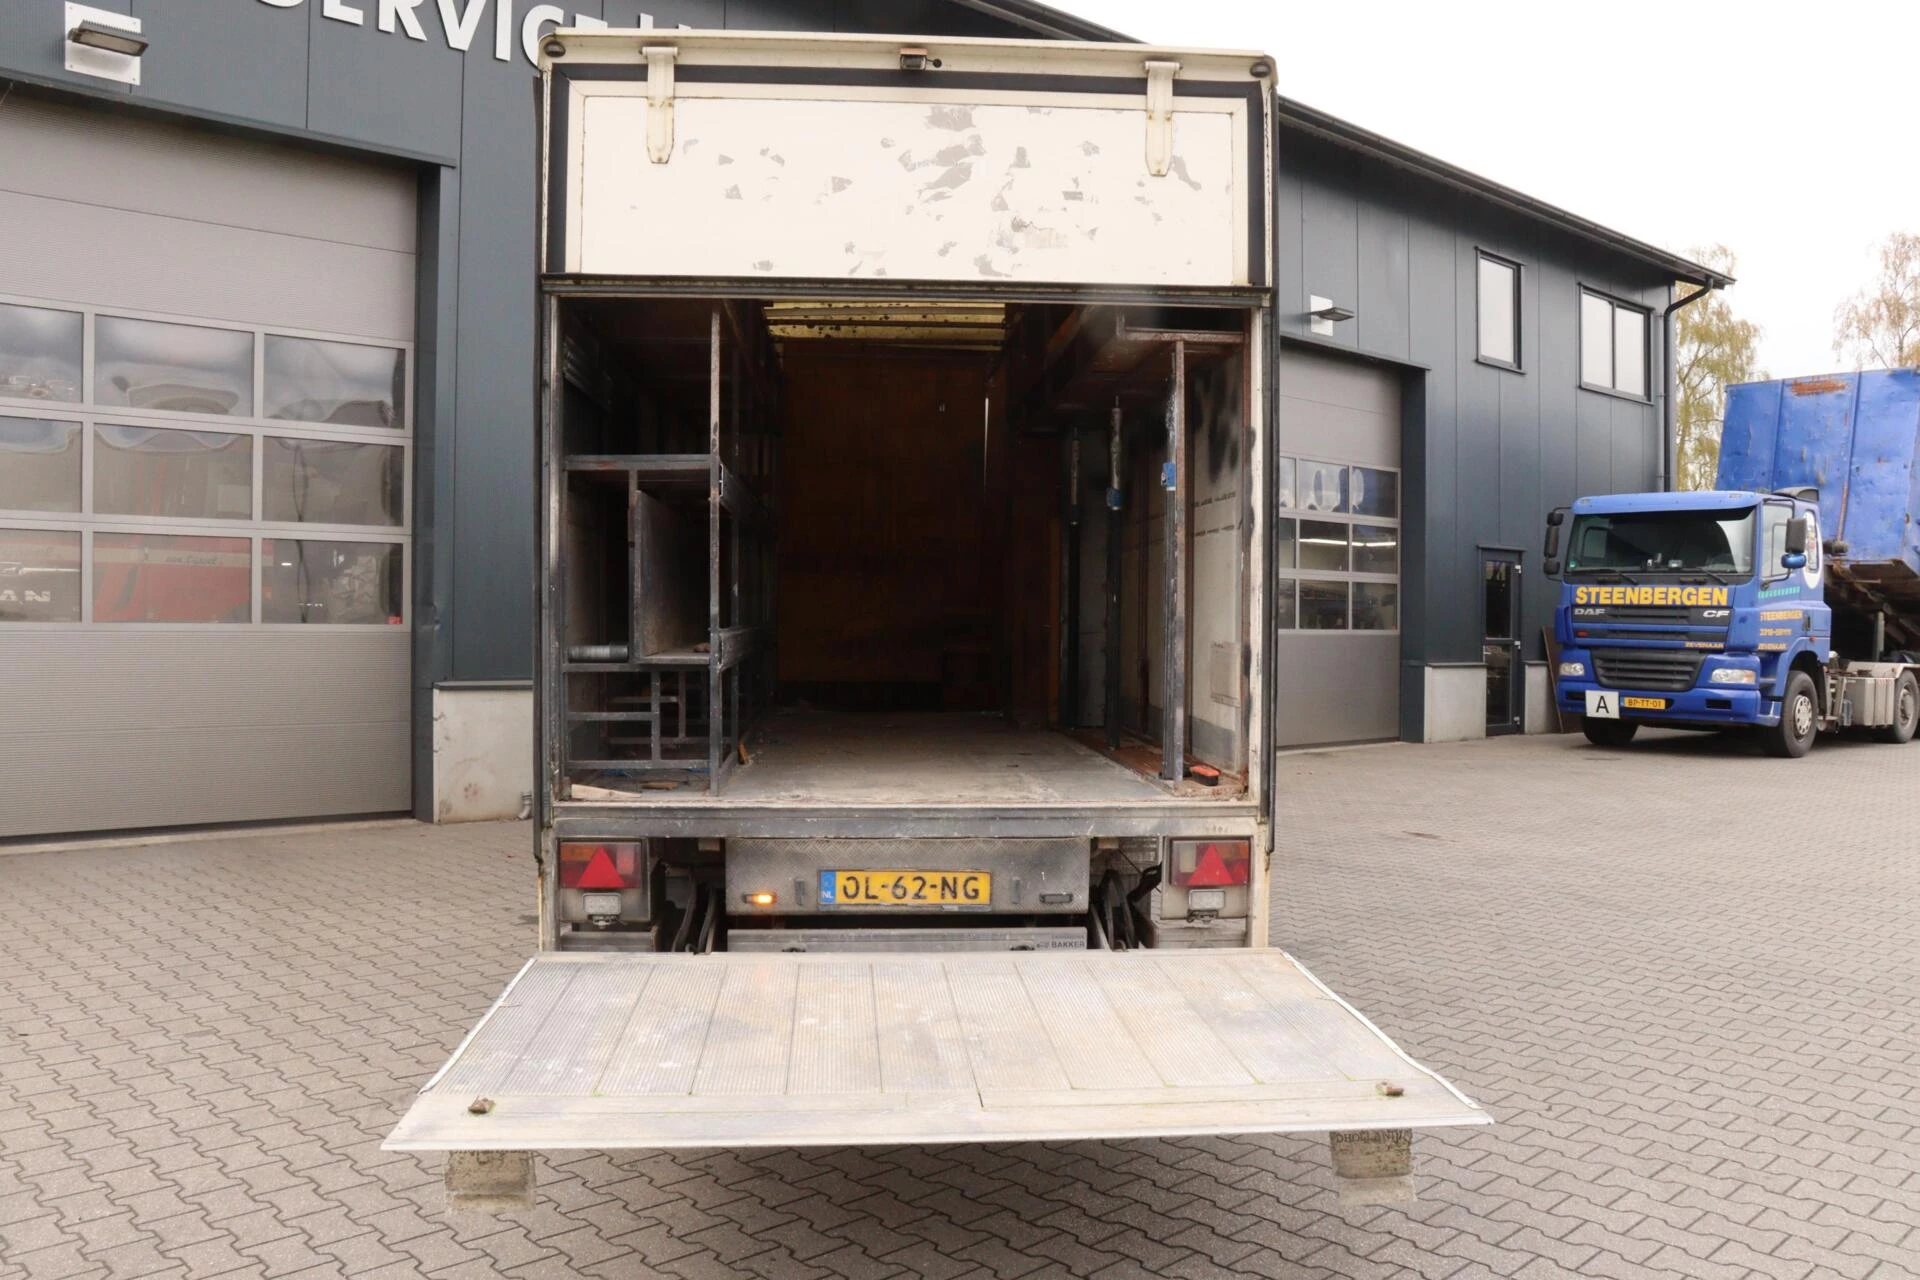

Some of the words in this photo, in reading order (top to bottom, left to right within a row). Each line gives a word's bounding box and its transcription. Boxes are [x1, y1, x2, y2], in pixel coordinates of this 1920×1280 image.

[1576, 586, 1728, 606] STEENBERGEN
[1574, 608, 1606, 616] DAF
[1703, 610, 1730, 618] CF
[1595, 695, 1610, 714] A
[843, 876, 980, 900] OL-62-NG
[821, 890, 834, 899] NL
[1051, 940, 1085, 948] BAKKER
